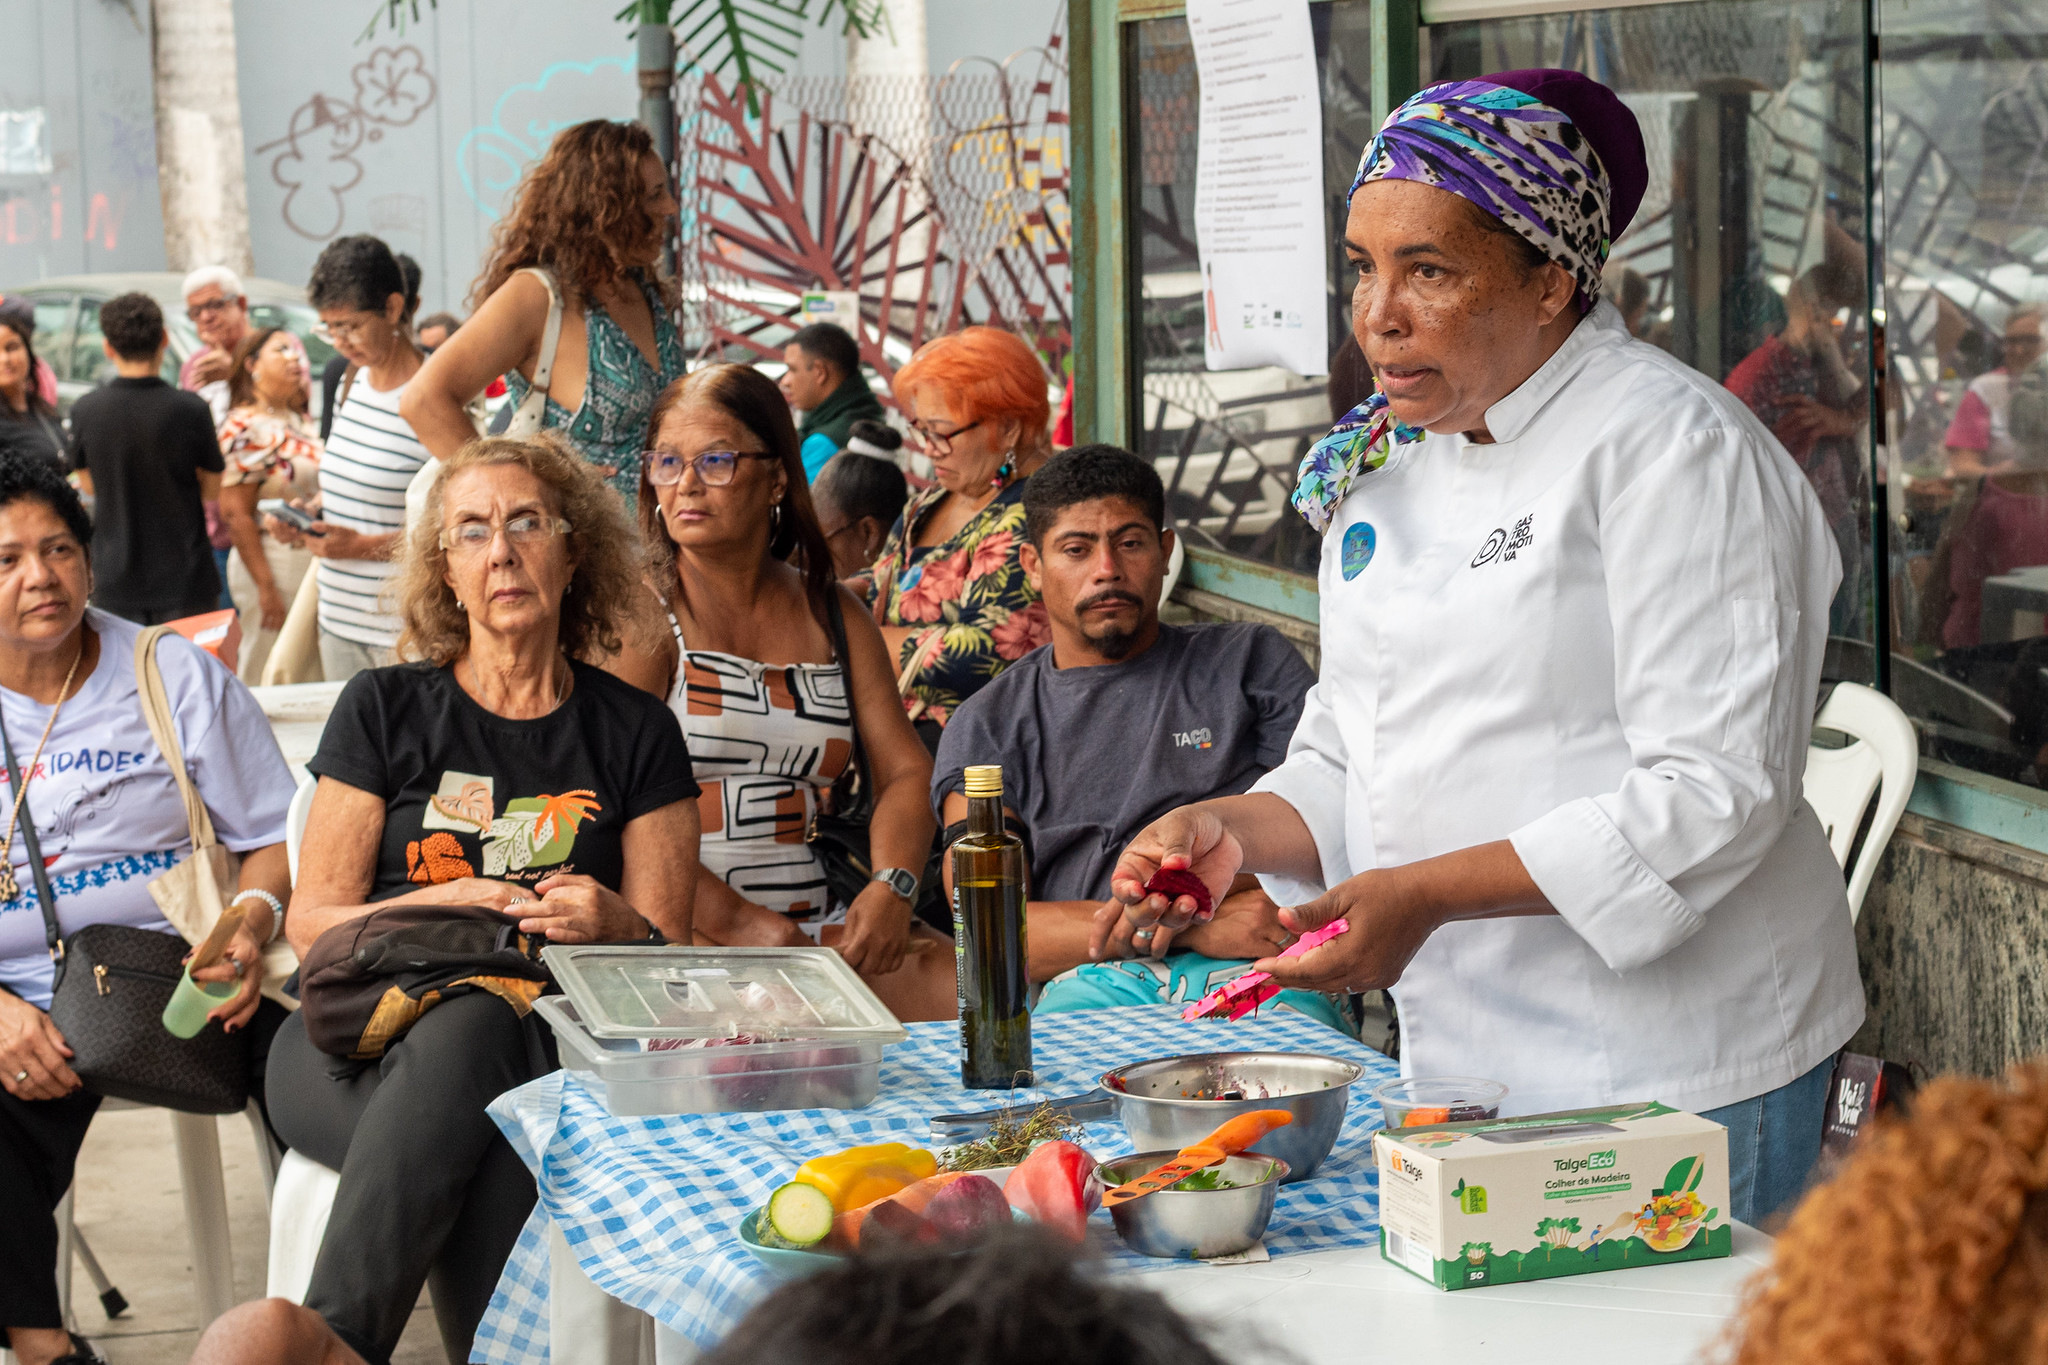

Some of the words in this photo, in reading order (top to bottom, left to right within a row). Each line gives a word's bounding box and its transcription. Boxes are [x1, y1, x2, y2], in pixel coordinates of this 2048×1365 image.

[1515, 512, 1534, 530] GAS
[1511, 526, 1531, 541] TRO
[1505, 534, 1534, 552] MOTI
[1503, 551, 1517, 563] VA
[1171, 727, 1212, 748] TACO
[1402, 1158, 1423, 1182] Talge
[1545, 1179, 1576, 1190] Colher
[1577, 1176, 1590, 1186] de
[1591, 1172, 1631, 1184] Madeira
[1469, 1271, 1485, 1281] 50
